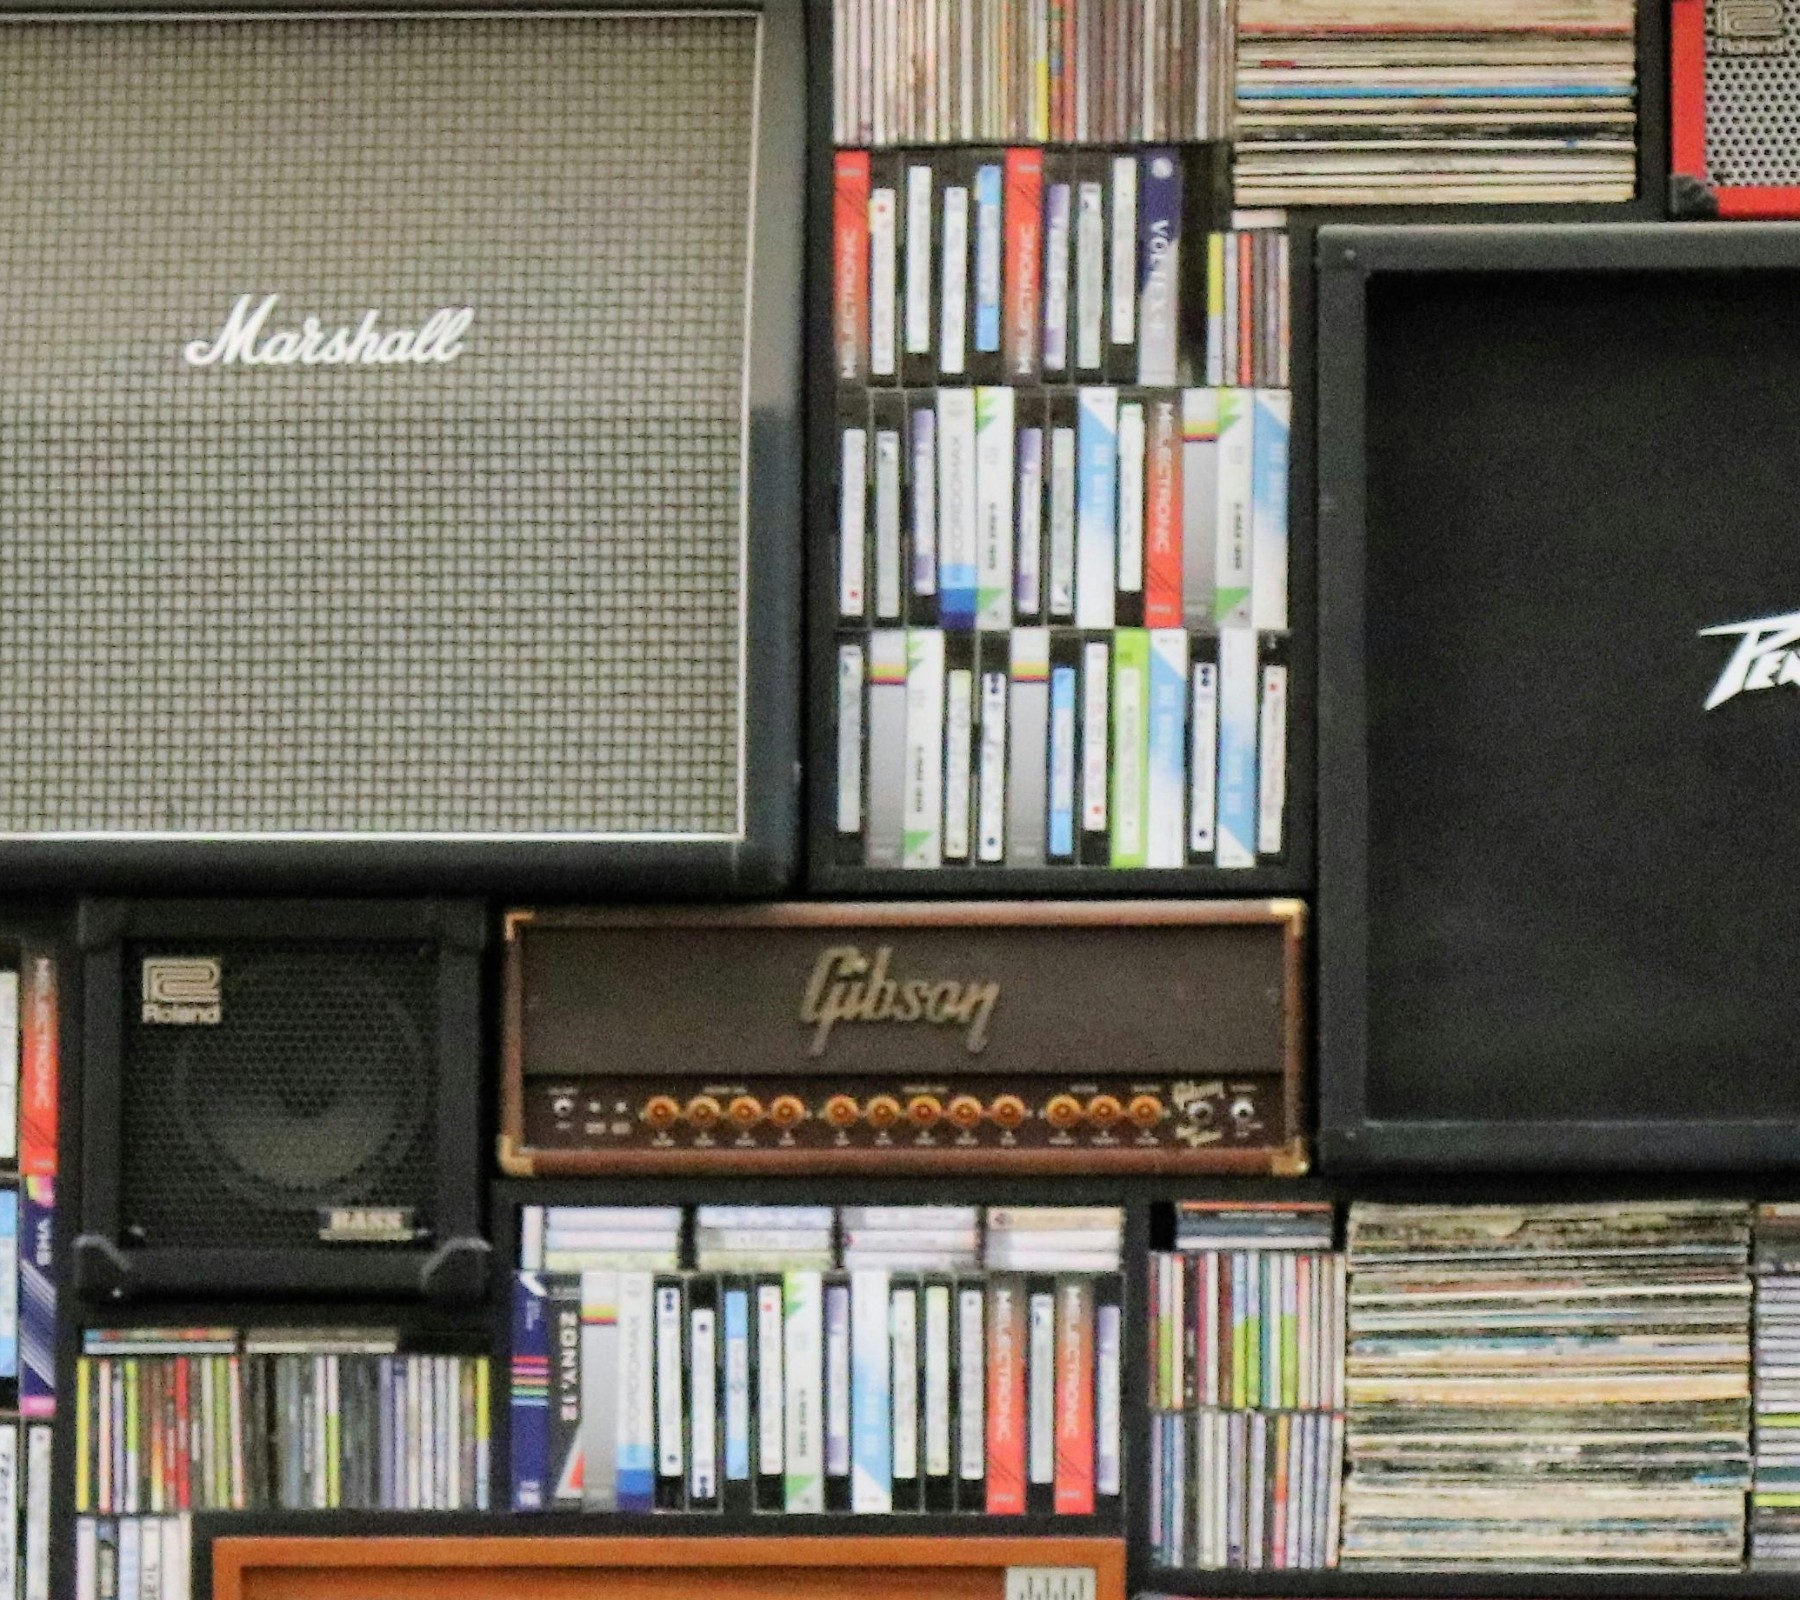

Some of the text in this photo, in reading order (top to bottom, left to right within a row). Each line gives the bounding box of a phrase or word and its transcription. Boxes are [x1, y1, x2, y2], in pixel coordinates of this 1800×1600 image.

[184, 293, 475, 365] Marshall
[142, 1002, 221, 1025] Roland
[800, 944, 1000, 1056] Gibson
[36, 1217, 53, 1266] VHS
